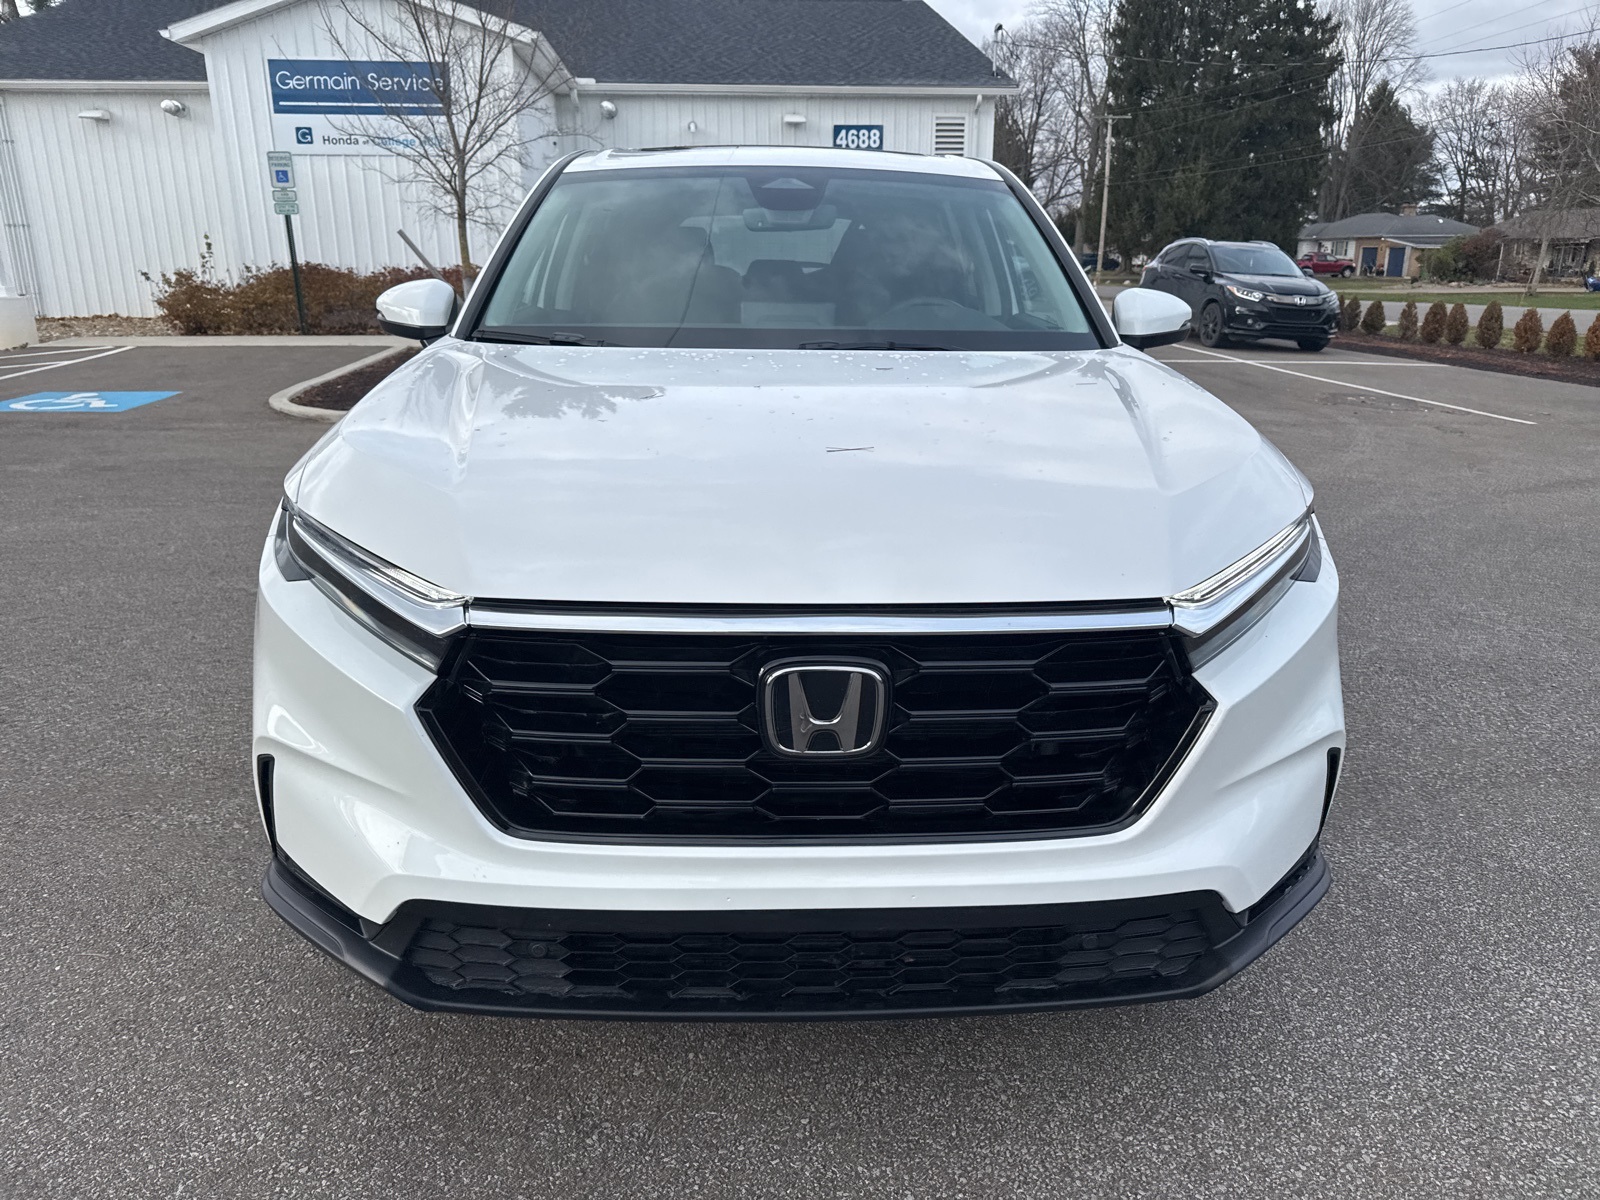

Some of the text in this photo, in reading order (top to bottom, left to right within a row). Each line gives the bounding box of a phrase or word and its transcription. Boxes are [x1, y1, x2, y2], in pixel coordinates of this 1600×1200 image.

[275, 71, 361, 90] Germain
[322, 135, 360, 145] Honda
[835, 129, 880, 149] 4688
